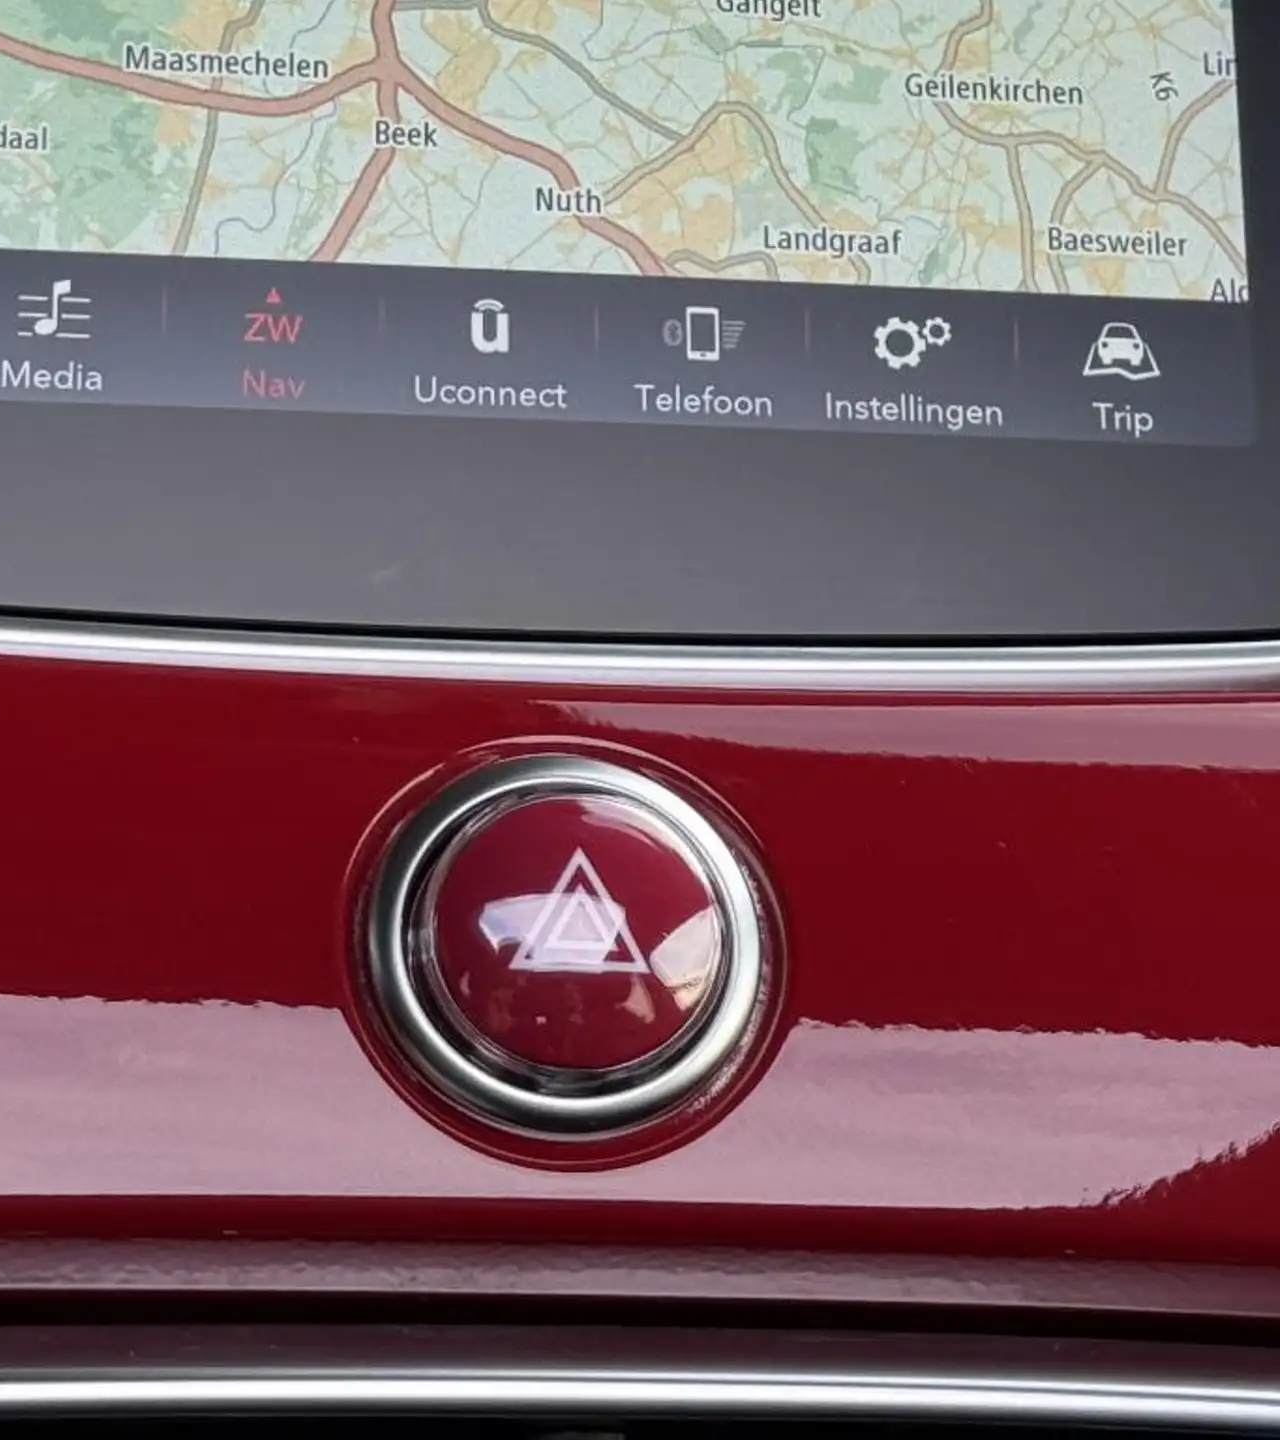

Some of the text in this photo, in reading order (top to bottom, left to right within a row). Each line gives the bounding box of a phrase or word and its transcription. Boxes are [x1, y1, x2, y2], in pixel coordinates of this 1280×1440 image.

[125, 45, 329, 79] Maasmechelen
[904, 72, 1084, 105] Geilenkirchen
[375, 119, 438, 148] Beek
[535, 187, 603, 214] Nuth
[763, 225, 903, 257] Landgraaf
[1047, 227, 1188, 256] Baesweiler
[243, 313, 303, 344] ZW
[0, 360, 104, 392] Media
[242, 370, 306, 400] Nav
[413, 375, 568, 410] Uconnect
[633, 383, 774, 418] Telefoon
[825, 391, 1004, 431] Instellingen
[1092, 402, 1153, 438] Trip
